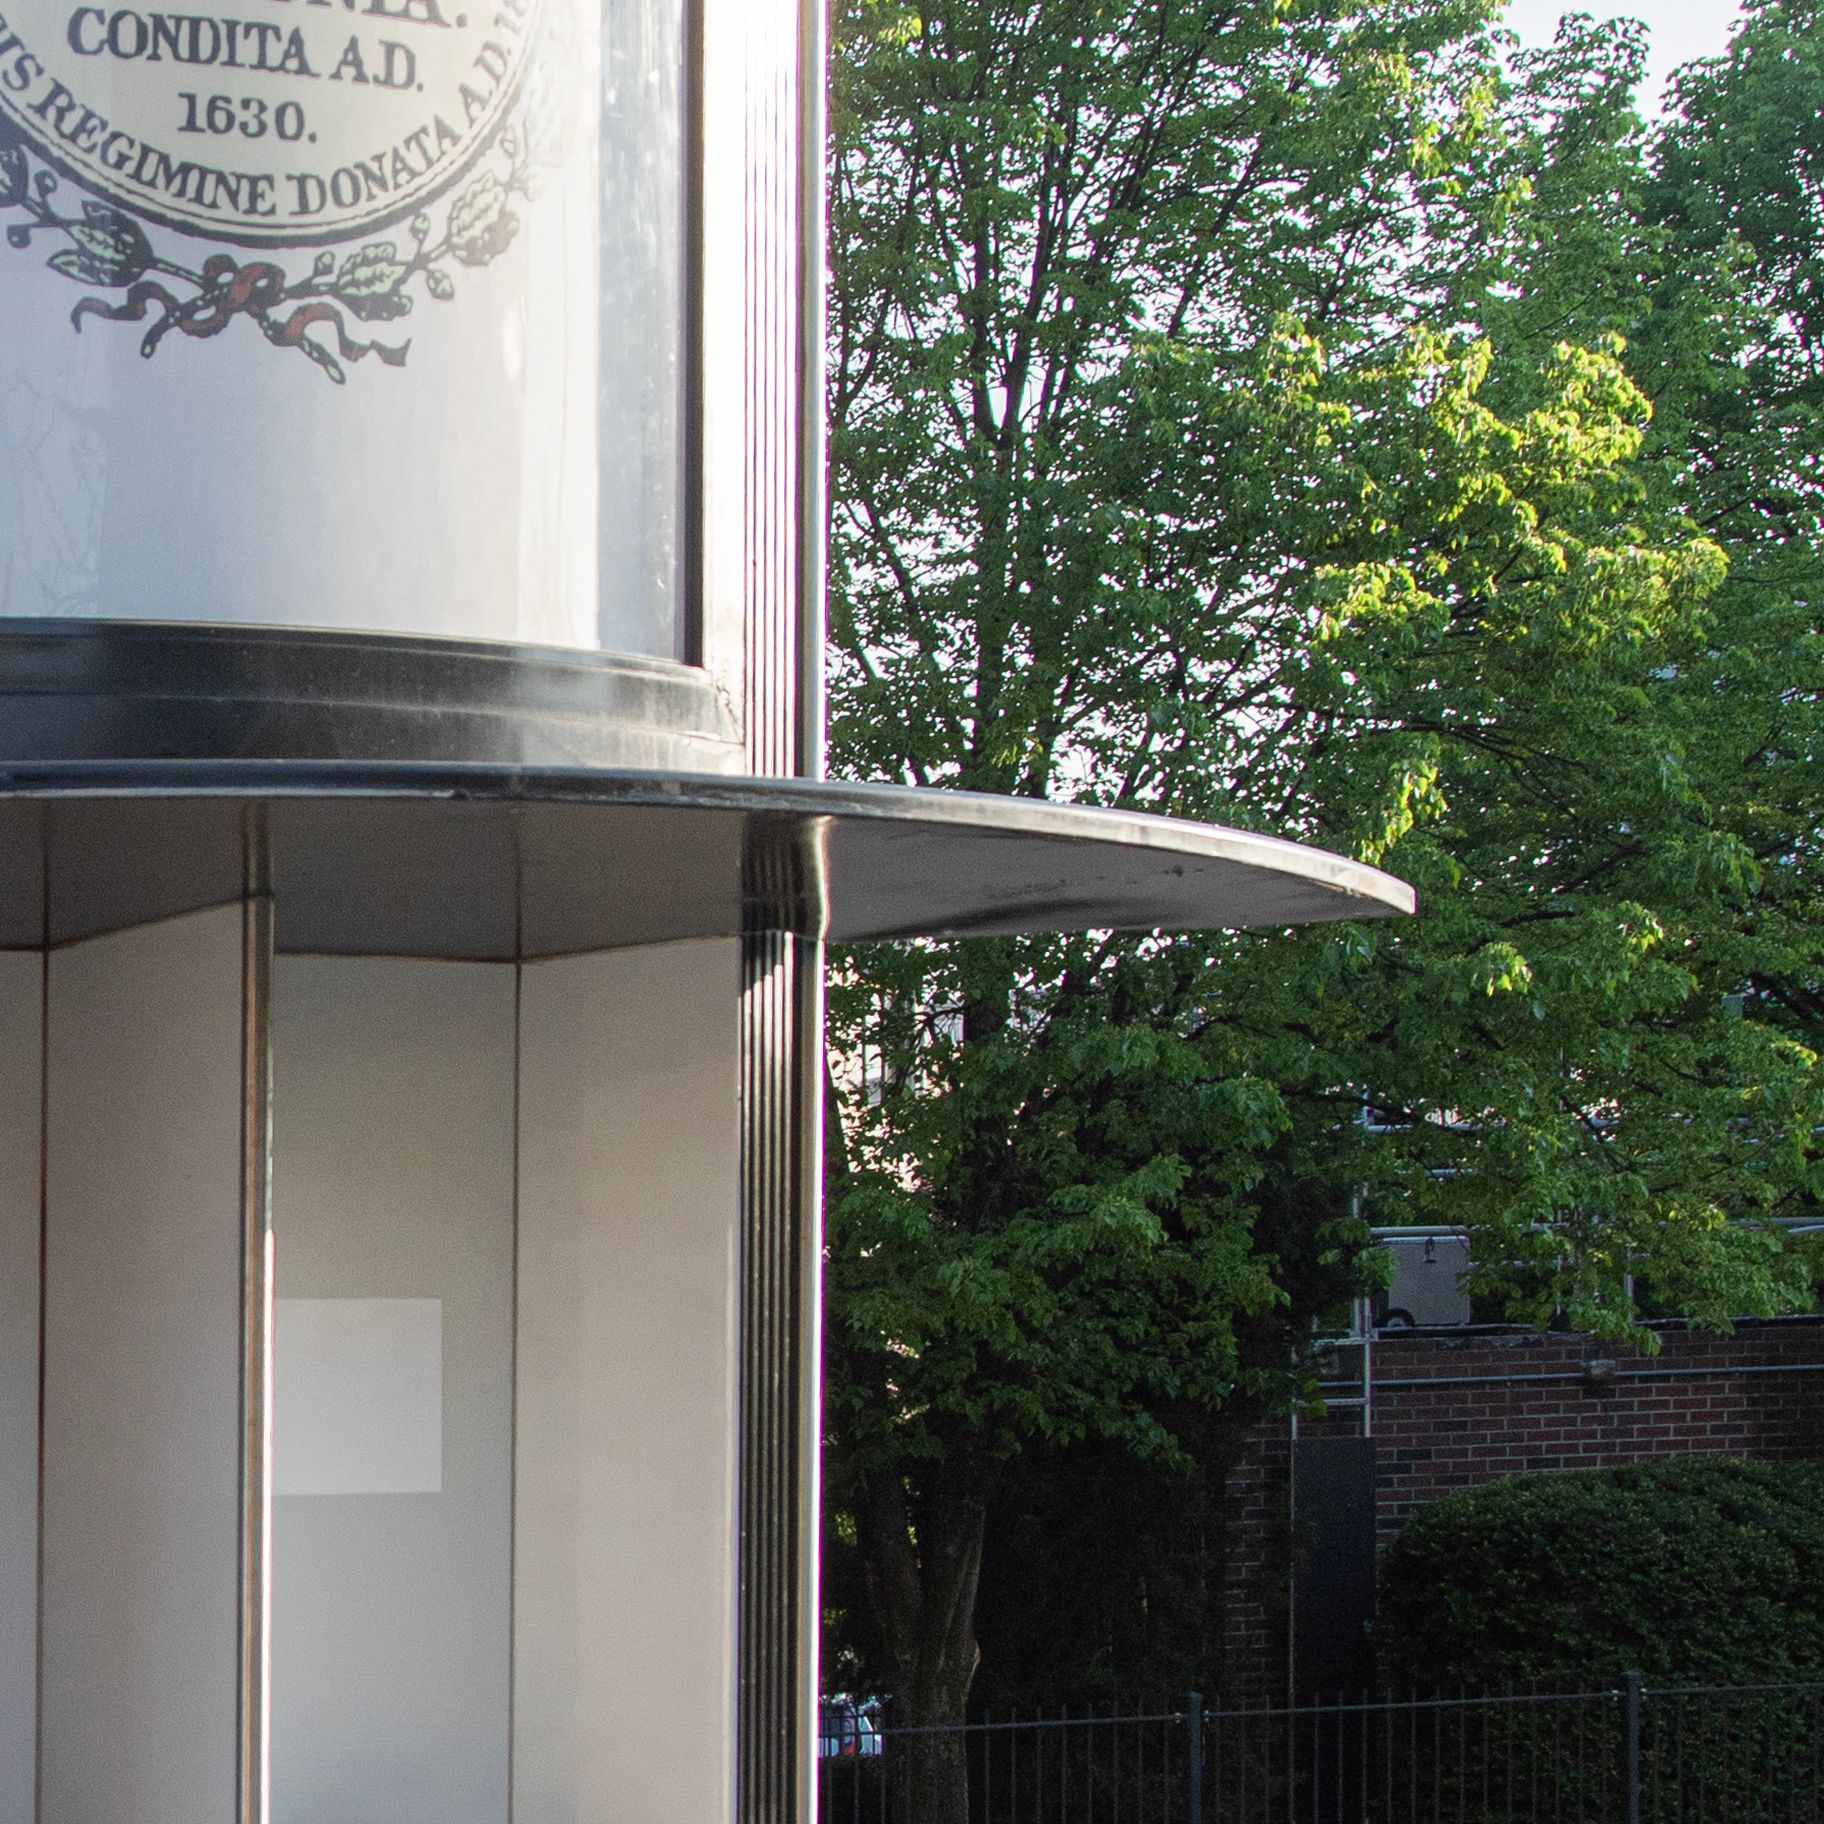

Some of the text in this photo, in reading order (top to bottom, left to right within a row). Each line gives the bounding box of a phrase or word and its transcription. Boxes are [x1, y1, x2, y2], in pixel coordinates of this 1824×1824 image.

[68, 7, 424, 92] CONDITA A.D.
[26, 77, 276, 216] REGIMINE
[286, 114, 462, 216] DONATA
[177, 92, 318, 143] 1630.
